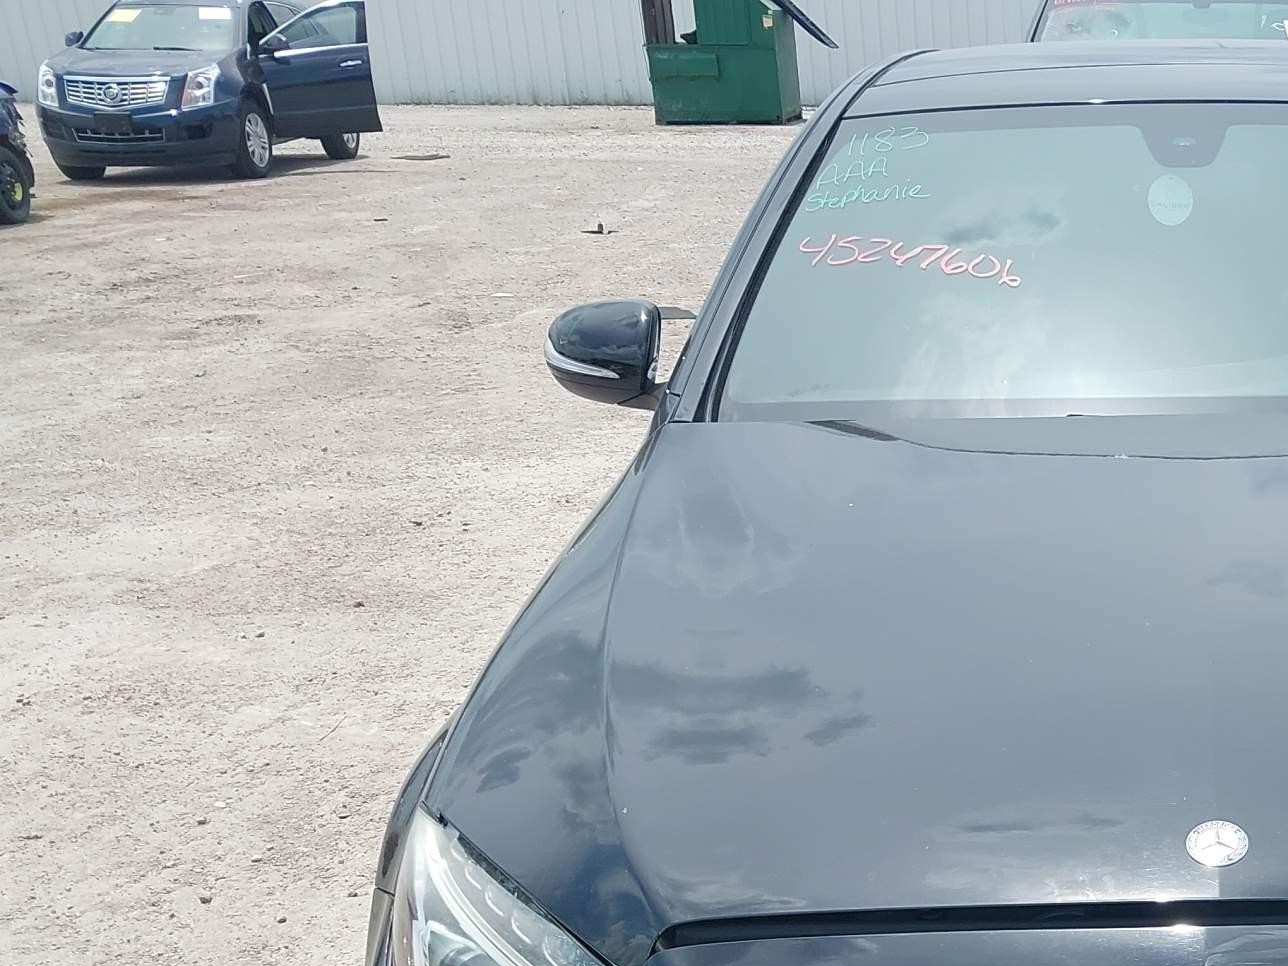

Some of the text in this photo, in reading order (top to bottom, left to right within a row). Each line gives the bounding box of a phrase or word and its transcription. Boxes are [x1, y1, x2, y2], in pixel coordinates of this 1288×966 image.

[848, 126, 929, 156] 1183
[816, 157, 889, 189] AAA
[805, 178, 932, 212] Stephanie
[799, 233, 1022, 288] 45247606
